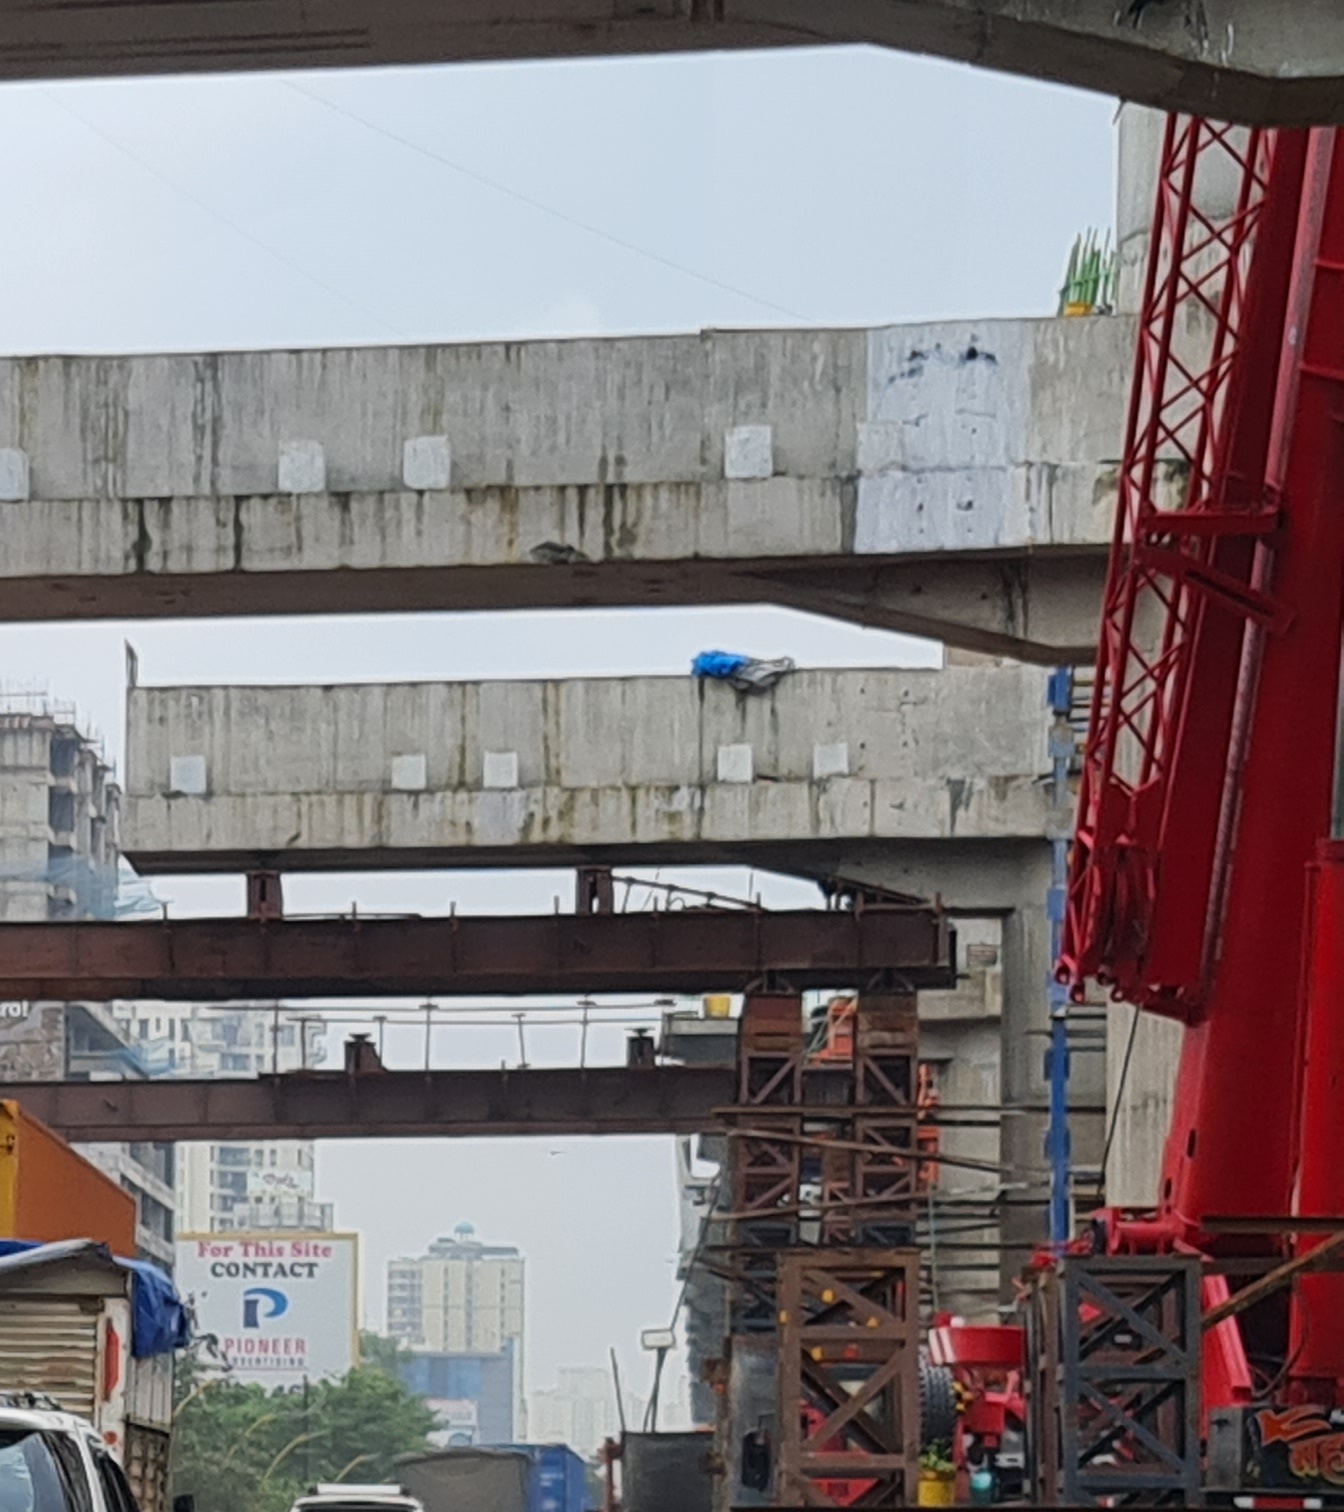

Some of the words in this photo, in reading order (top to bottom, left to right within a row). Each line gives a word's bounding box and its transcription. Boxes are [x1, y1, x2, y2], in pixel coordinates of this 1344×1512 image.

[197, 1241, 234, 1258] For
[239, 1241, 285, 1258] This
[290, 1241, 333, 1258] Site
[210, 1262, 319, 1279] CONTACT
[224, 1338, 306, 1355] PIONEER
